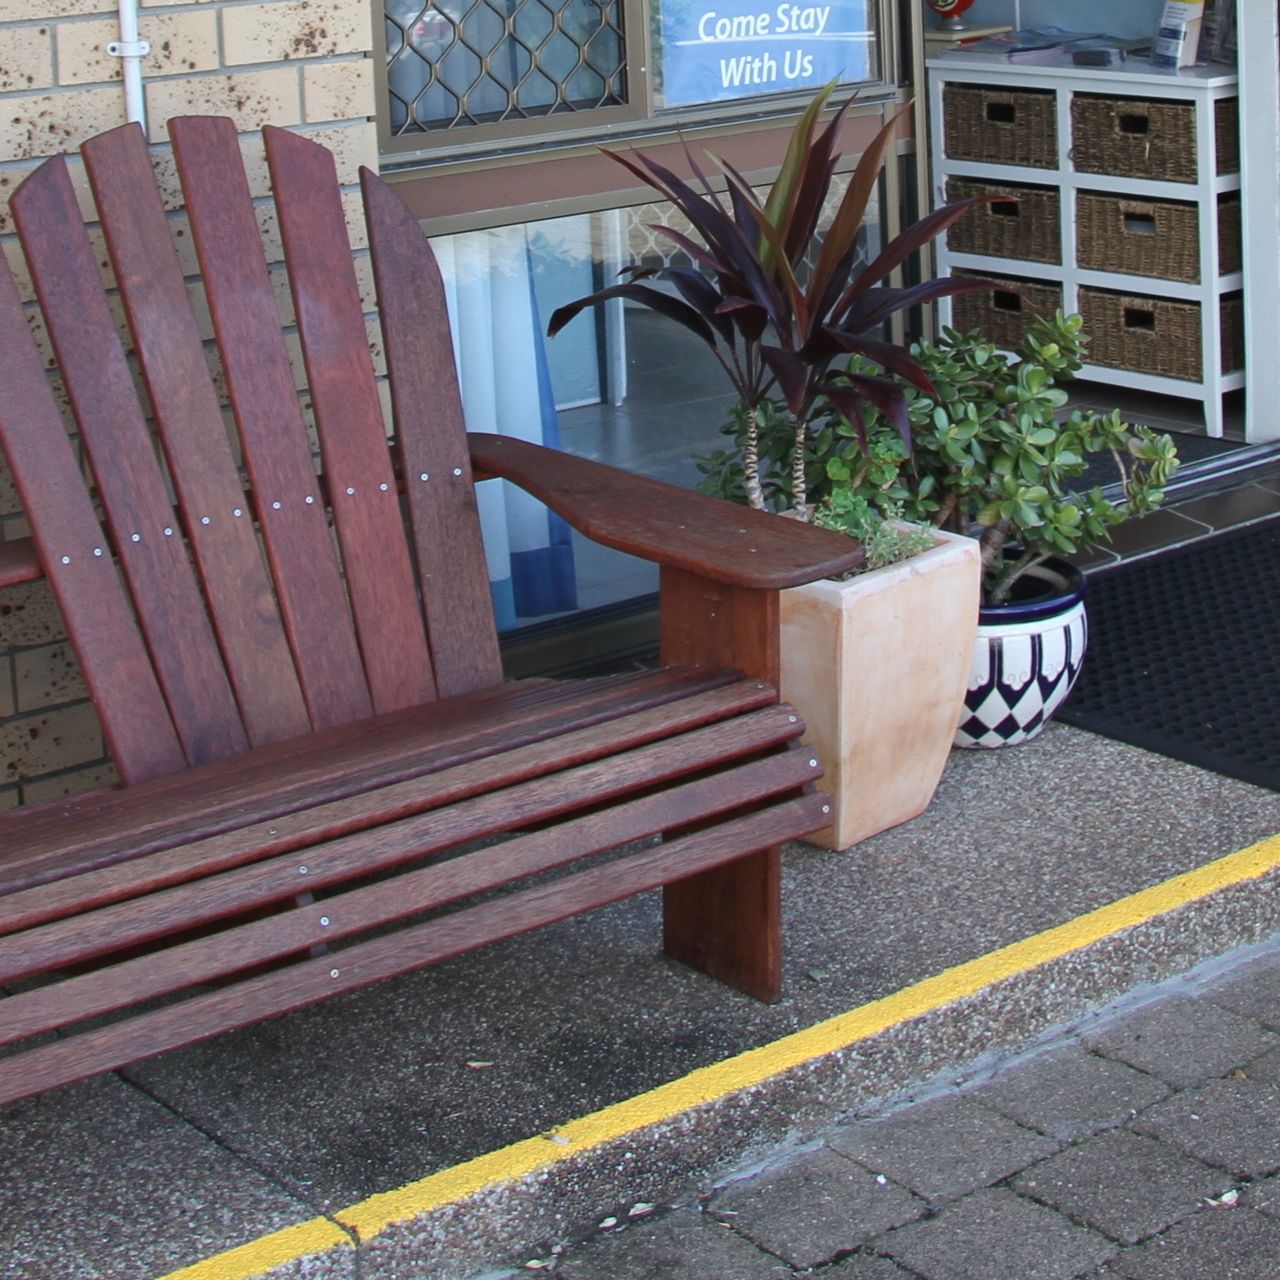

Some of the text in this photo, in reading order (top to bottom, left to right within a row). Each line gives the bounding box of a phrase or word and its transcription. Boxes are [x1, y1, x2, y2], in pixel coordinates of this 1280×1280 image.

[698, 3, 831, 42] Come Stay
[720, 49, 814, 88] With Us
